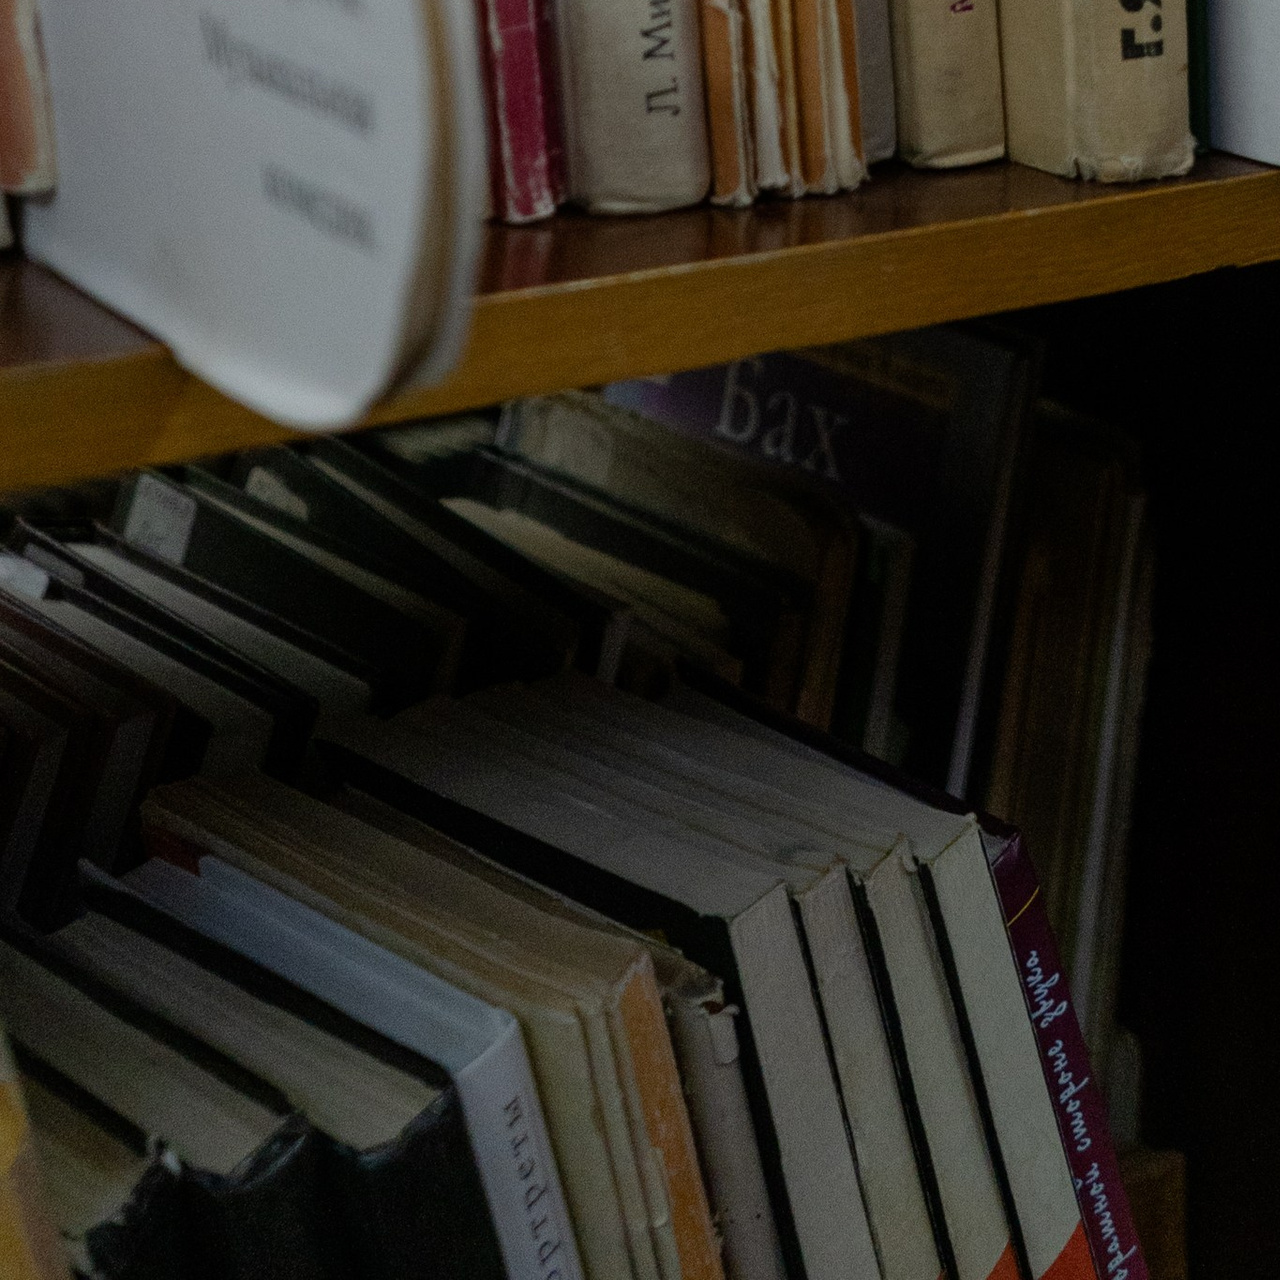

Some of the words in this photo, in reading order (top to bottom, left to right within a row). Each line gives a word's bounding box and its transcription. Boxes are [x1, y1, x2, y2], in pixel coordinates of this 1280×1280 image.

[713, 358, 852, 482] Бах
[1024, 949, 1068, 1030] звука
[1046, 1039, 1091, 1152] стороне
